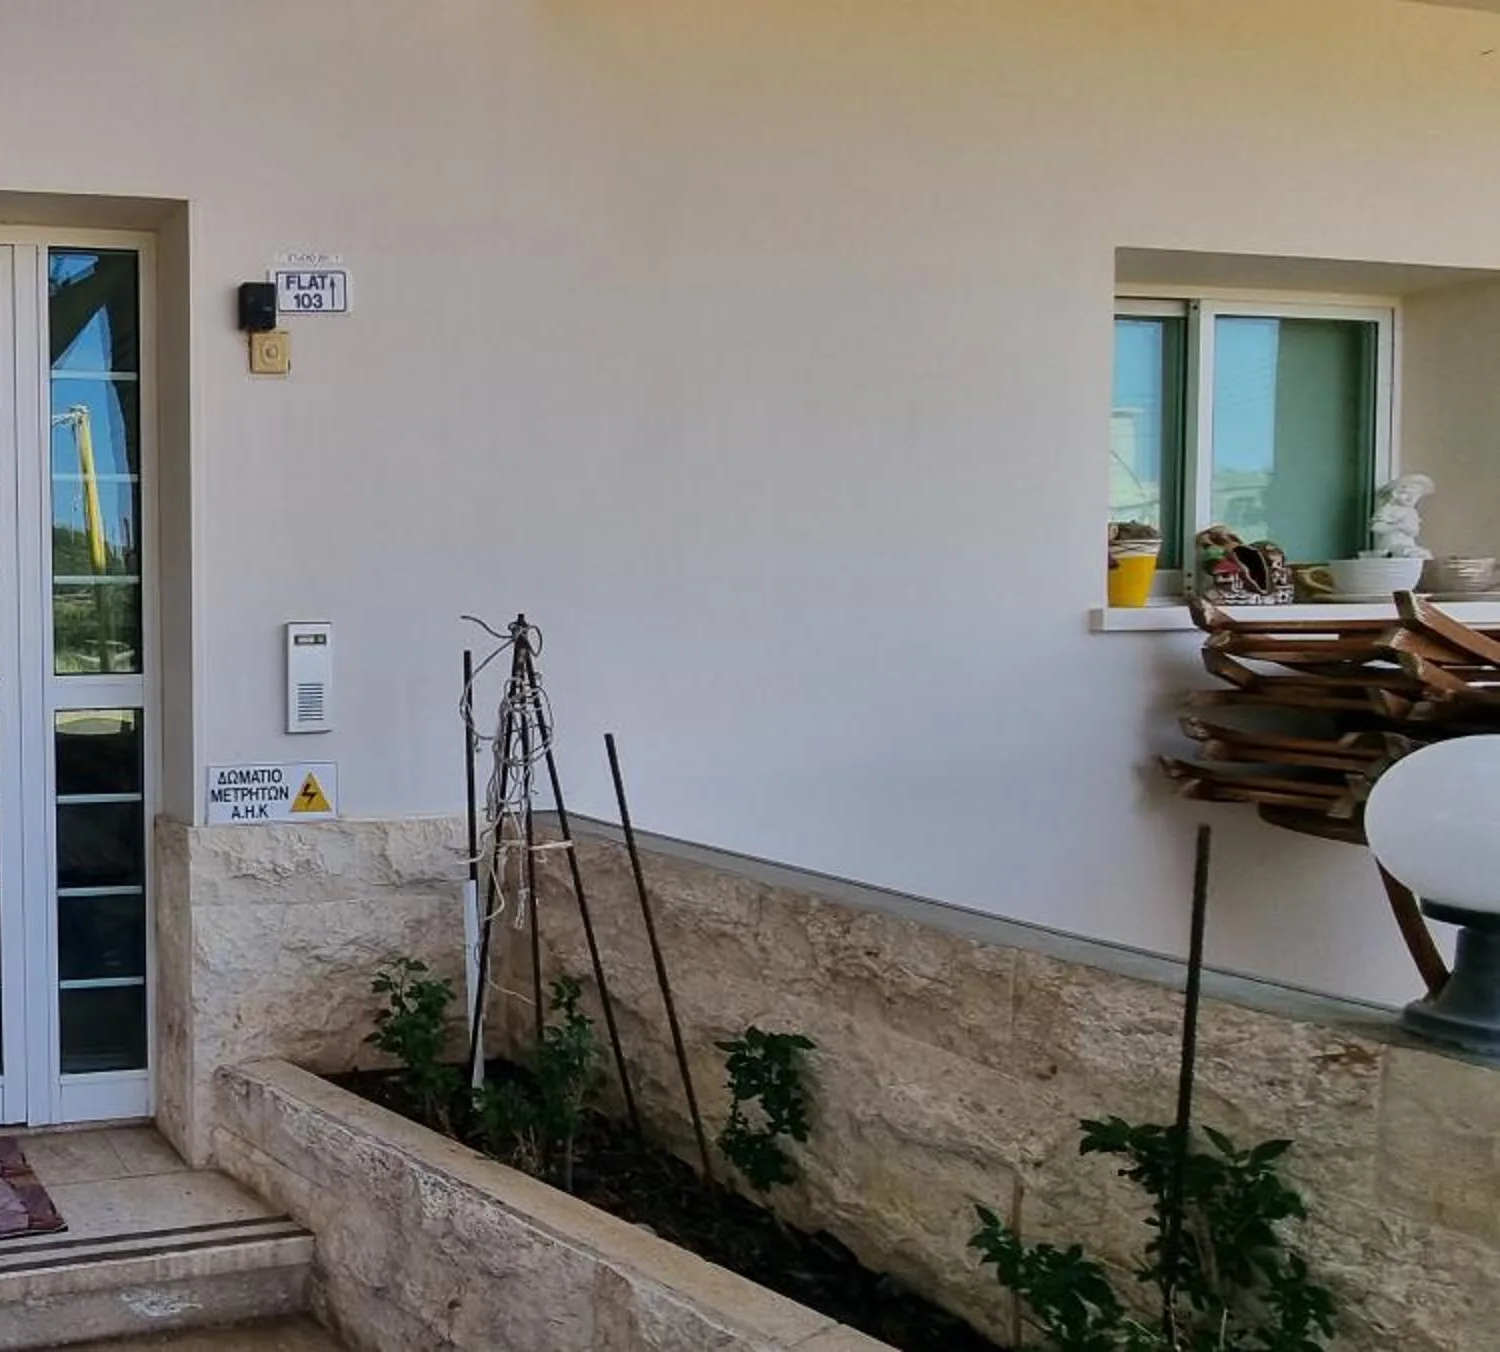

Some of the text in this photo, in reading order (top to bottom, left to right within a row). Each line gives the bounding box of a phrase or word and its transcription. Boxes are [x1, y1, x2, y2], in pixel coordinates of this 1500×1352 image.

[285, 275, 329, 291] FLAT
[293, 293, 324, 309] 103
[217, 768, 283, 785] ΔΩΜΑΤΙΟ
[211, 786, 289, 803] ΜΕΤΡΗΤΩΝ
